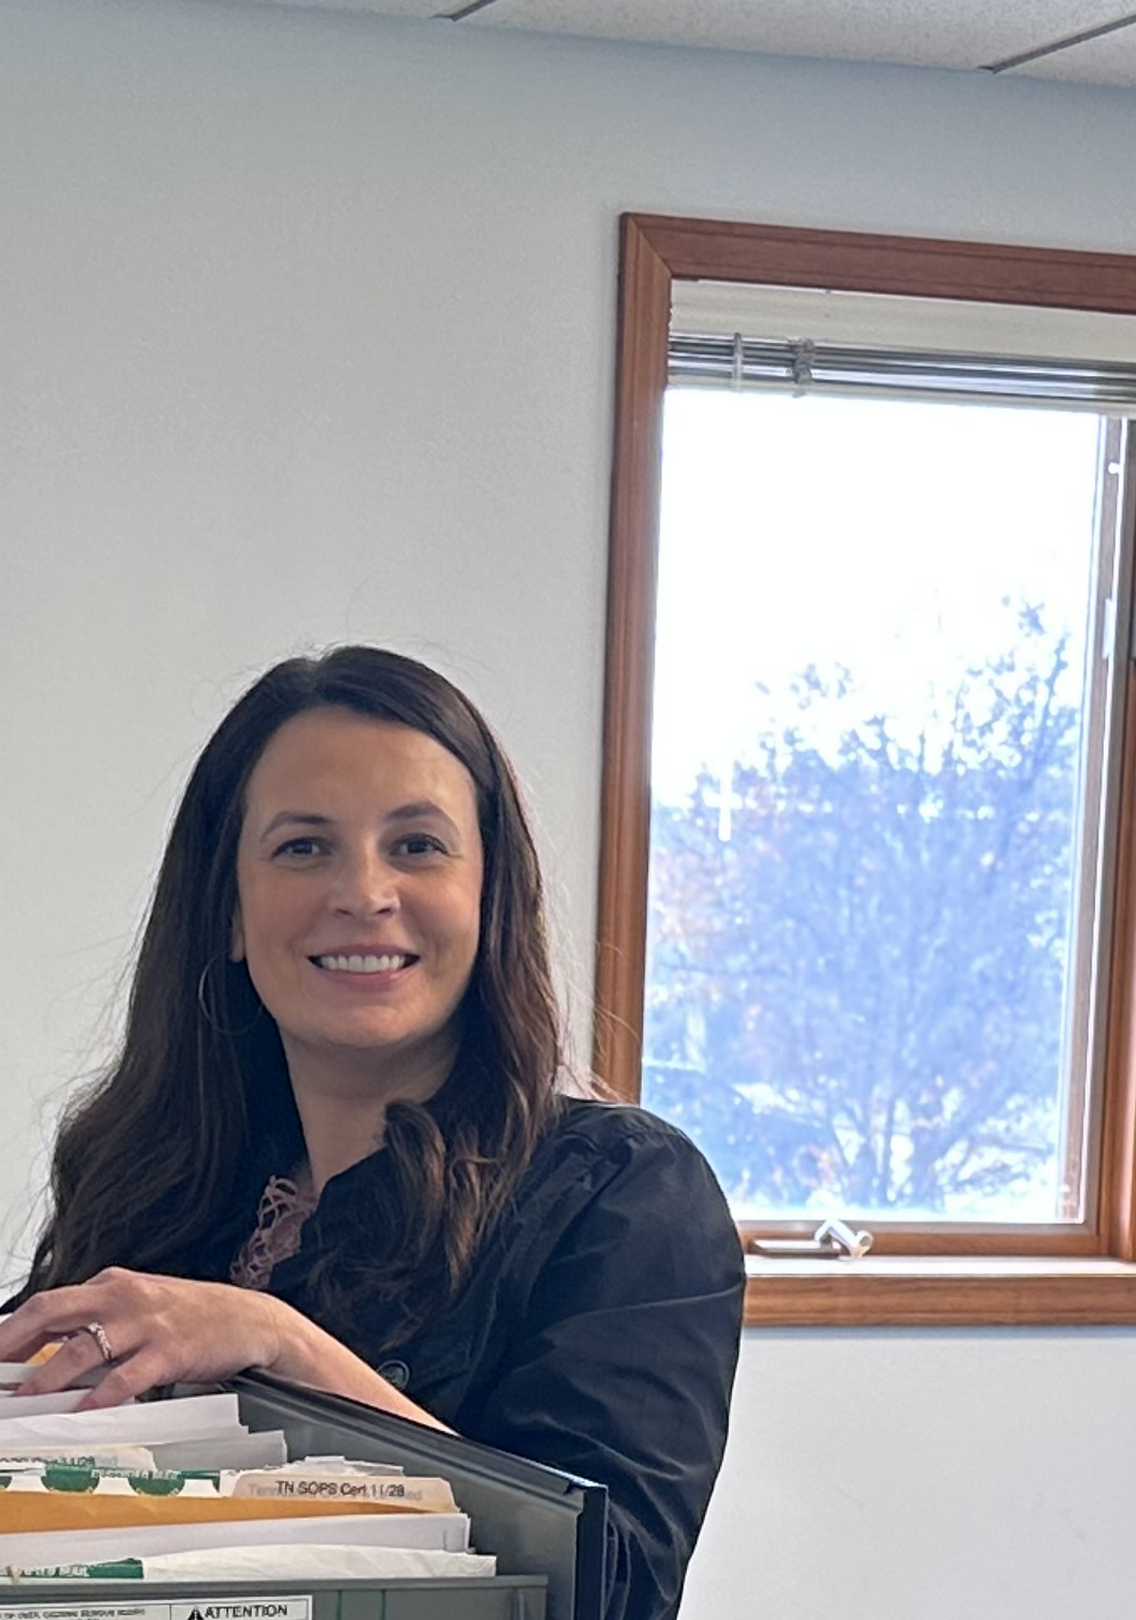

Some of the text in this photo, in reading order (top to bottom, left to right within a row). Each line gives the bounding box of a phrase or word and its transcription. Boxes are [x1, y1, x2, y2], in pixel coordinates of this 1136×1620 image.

[277, 1480, 294, 1496] TN
[298, 1481, 337, 1496] SOPS
[205, 1604, 288, 1619] ATTENTION
